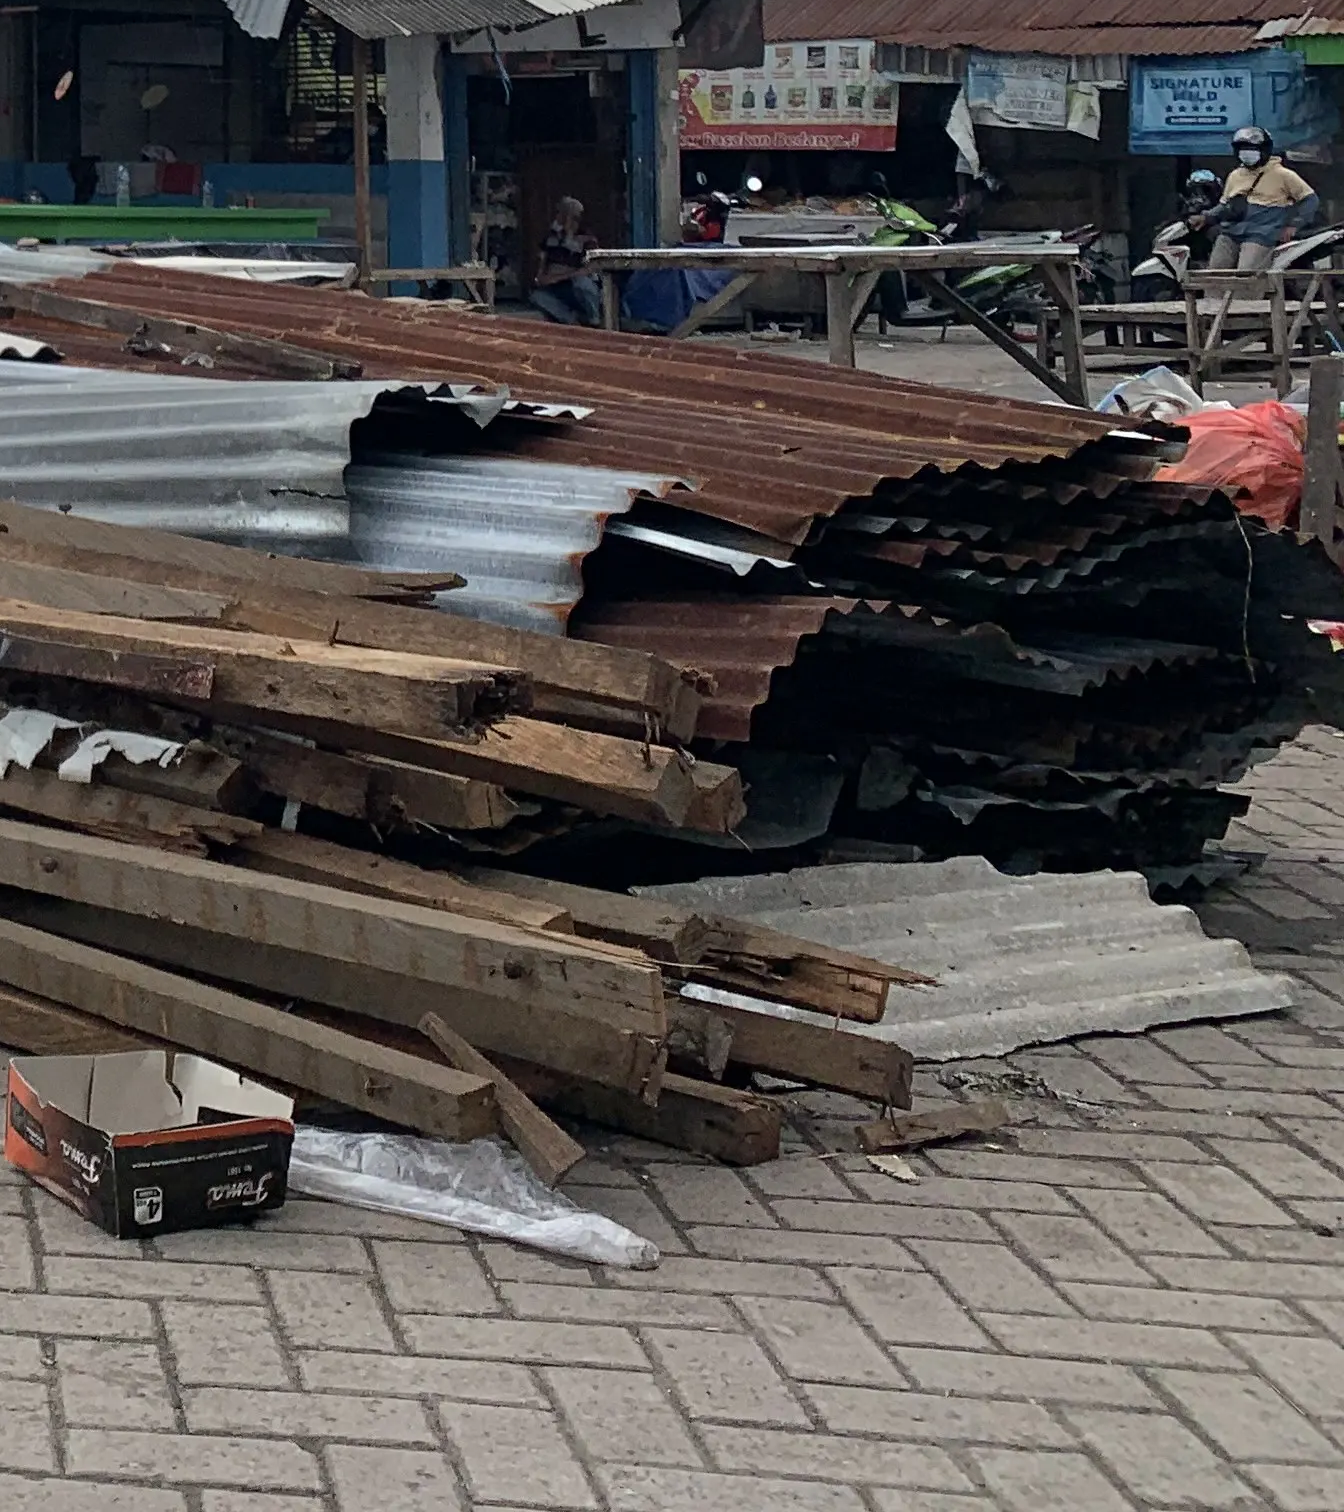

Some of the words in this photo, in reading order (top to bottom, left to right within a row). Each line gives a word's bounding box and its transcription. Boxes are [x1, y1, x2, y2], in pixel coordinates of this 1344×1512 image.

[1150, 76, 1244, 89] SIGNATURE
[207, 1172, 274, 1207] Fema
[148, 1199, 160, 1221] 4
